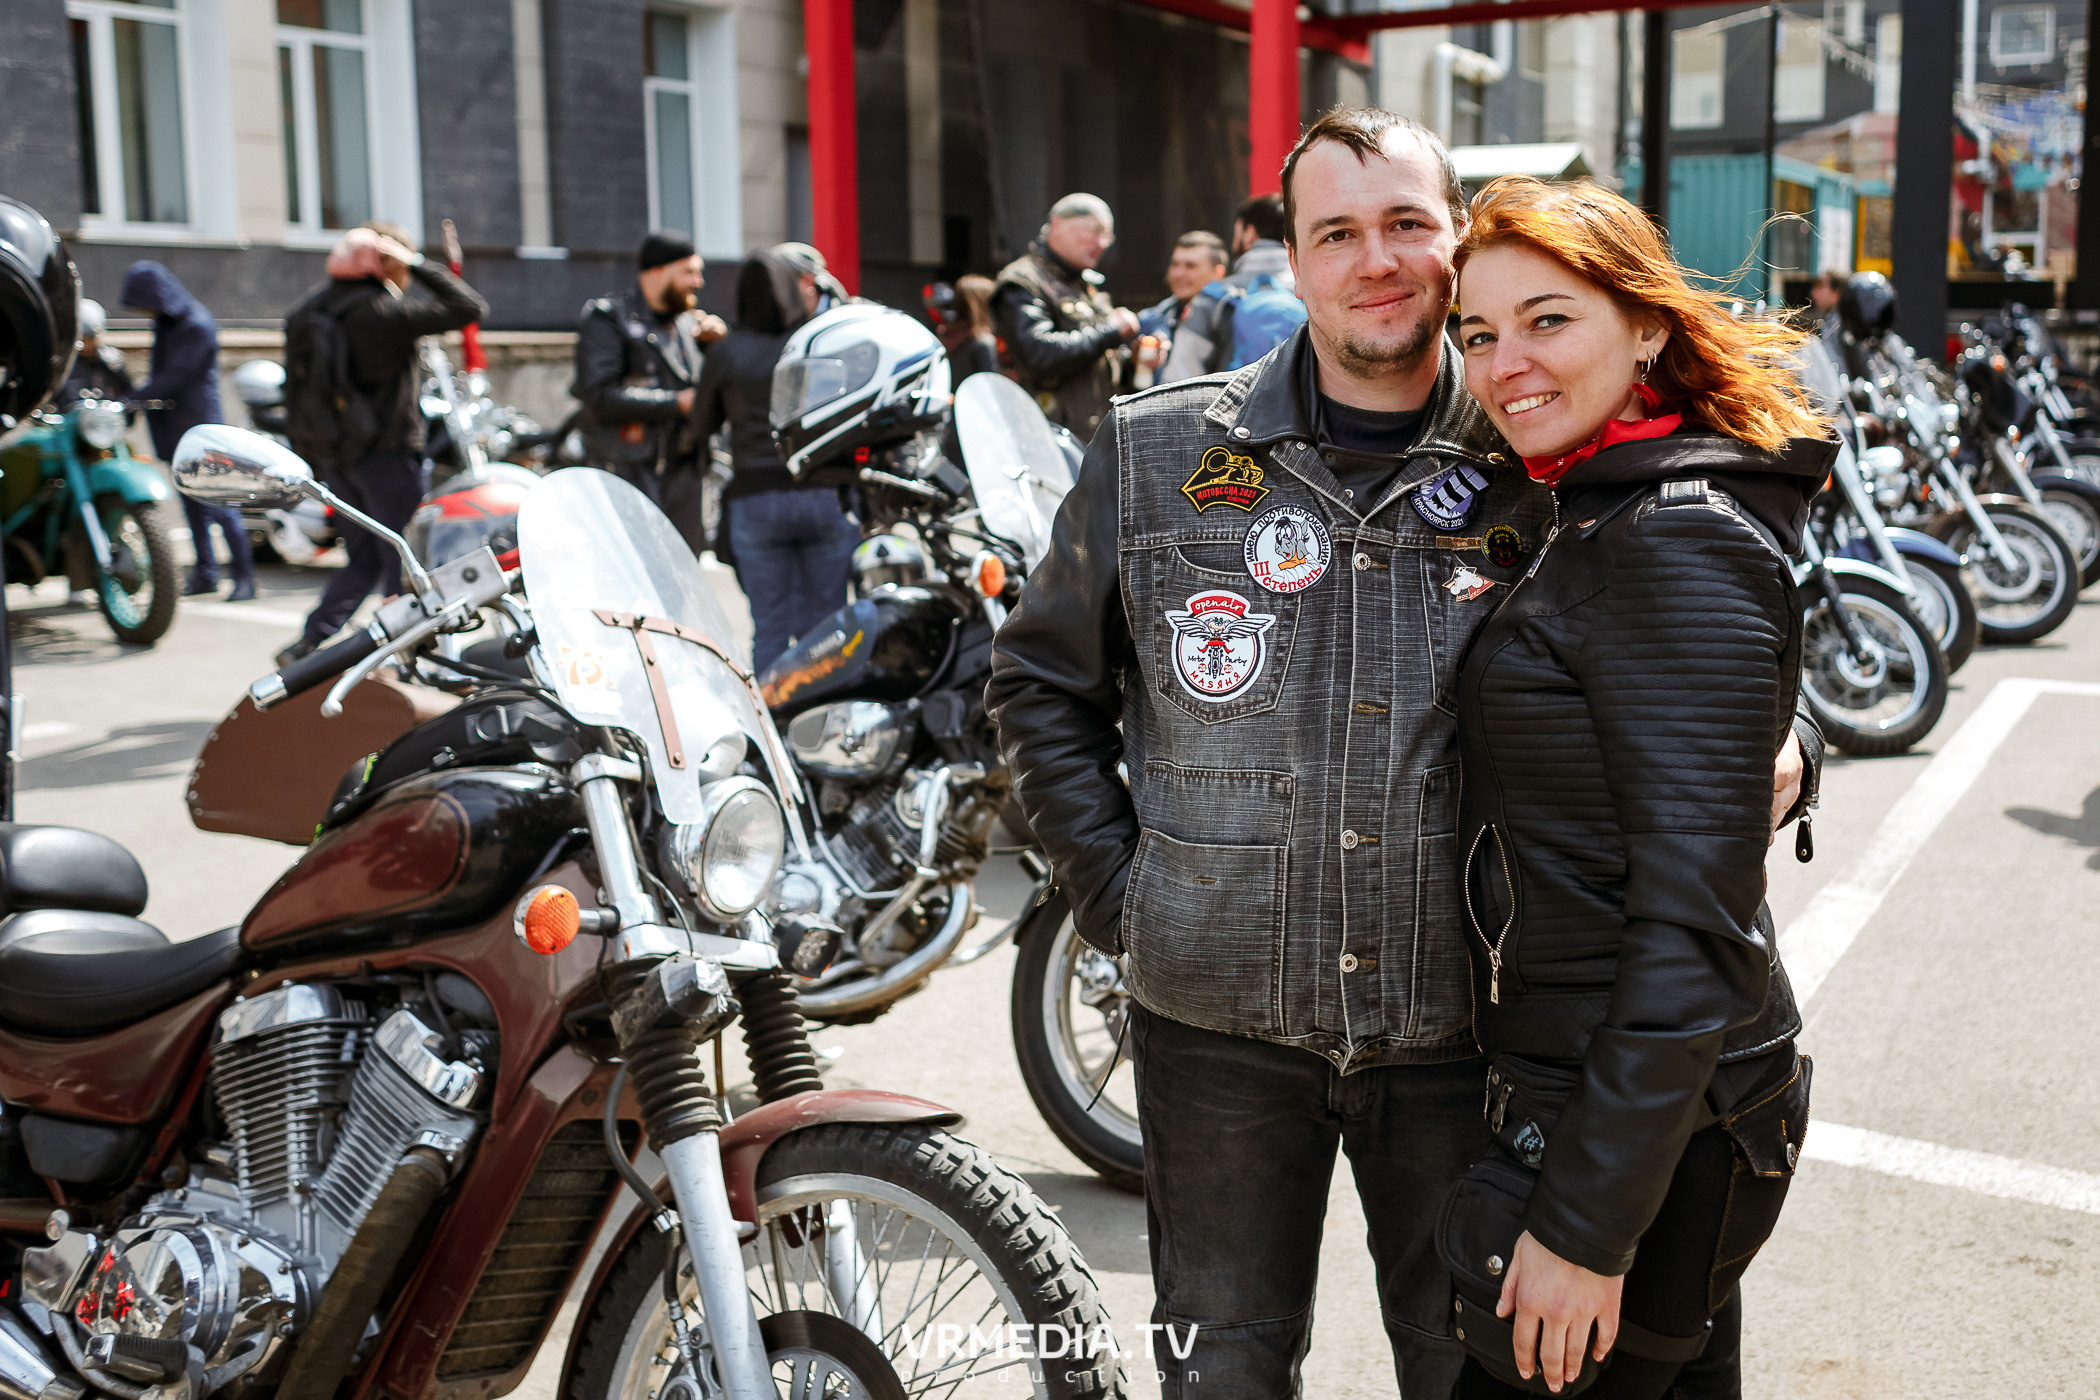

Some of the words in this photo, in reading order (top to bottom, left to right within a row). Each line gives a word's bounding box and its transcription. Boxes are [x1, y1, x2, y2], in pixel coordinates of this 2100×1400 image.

[1239, 487, 1257, 499] 2021
[1413, 497, 1450, 528] КРАСНОЯРСК
[1450, 518, 1464, 527] 2021
[1194, 598, 1244, 612] openair
[1187, 655, 1206, 663] Moto
[1224, 655, 1248, 667] Party
